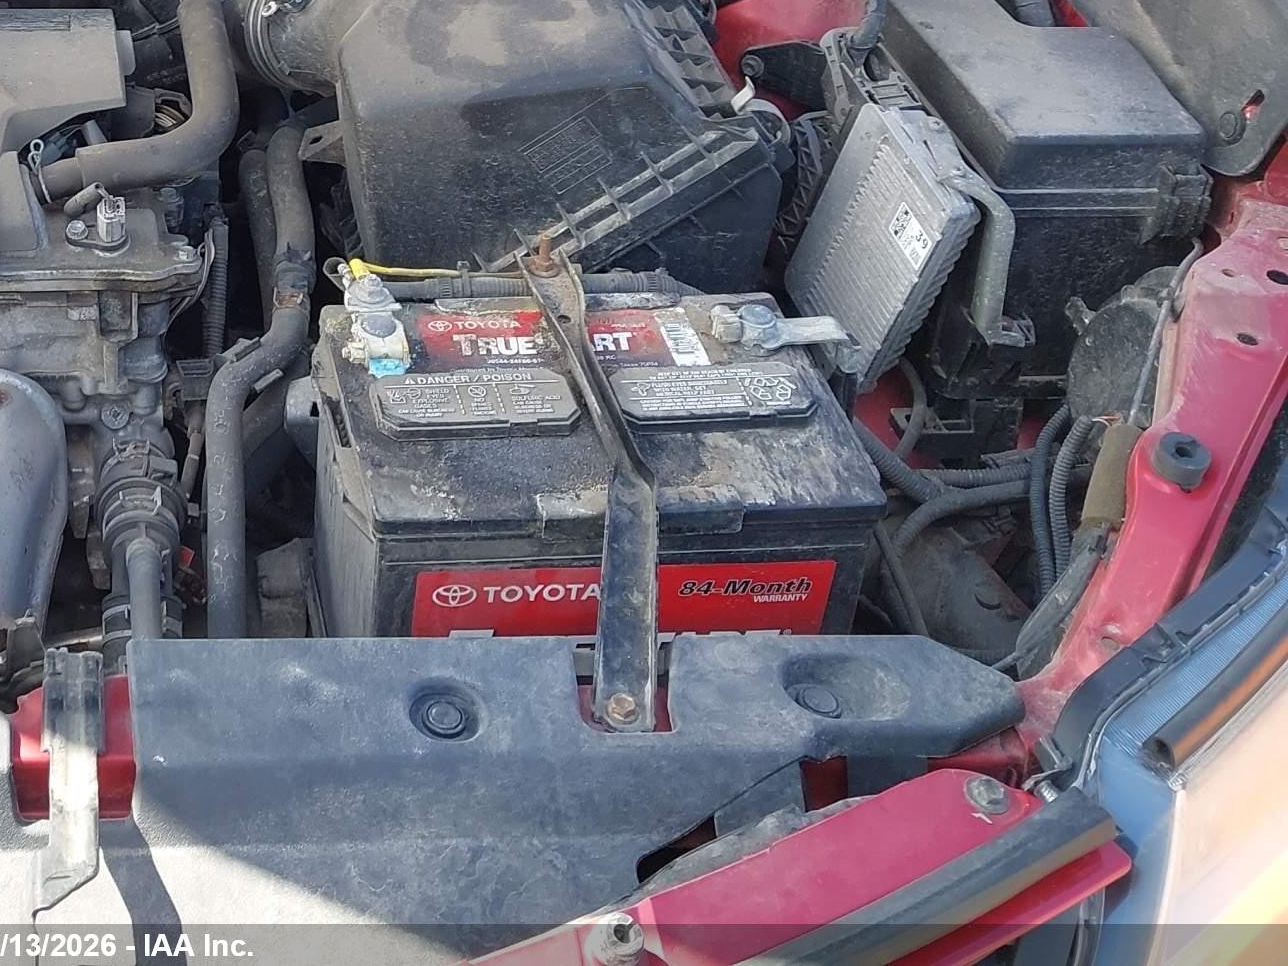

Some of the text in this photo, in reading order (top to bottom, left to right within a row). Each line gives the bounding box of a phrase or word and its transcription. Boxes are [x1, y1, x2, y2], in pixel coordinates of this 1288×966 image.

[453, 320, 522, 330] TOYOTA
[417, 374, 470, 385] DANGER
[483, 372, 532, 382] POISON
[484, 577, 812, 604] TOYOTA 84-Month
[753, 593, 808, 604] WARRANTY
